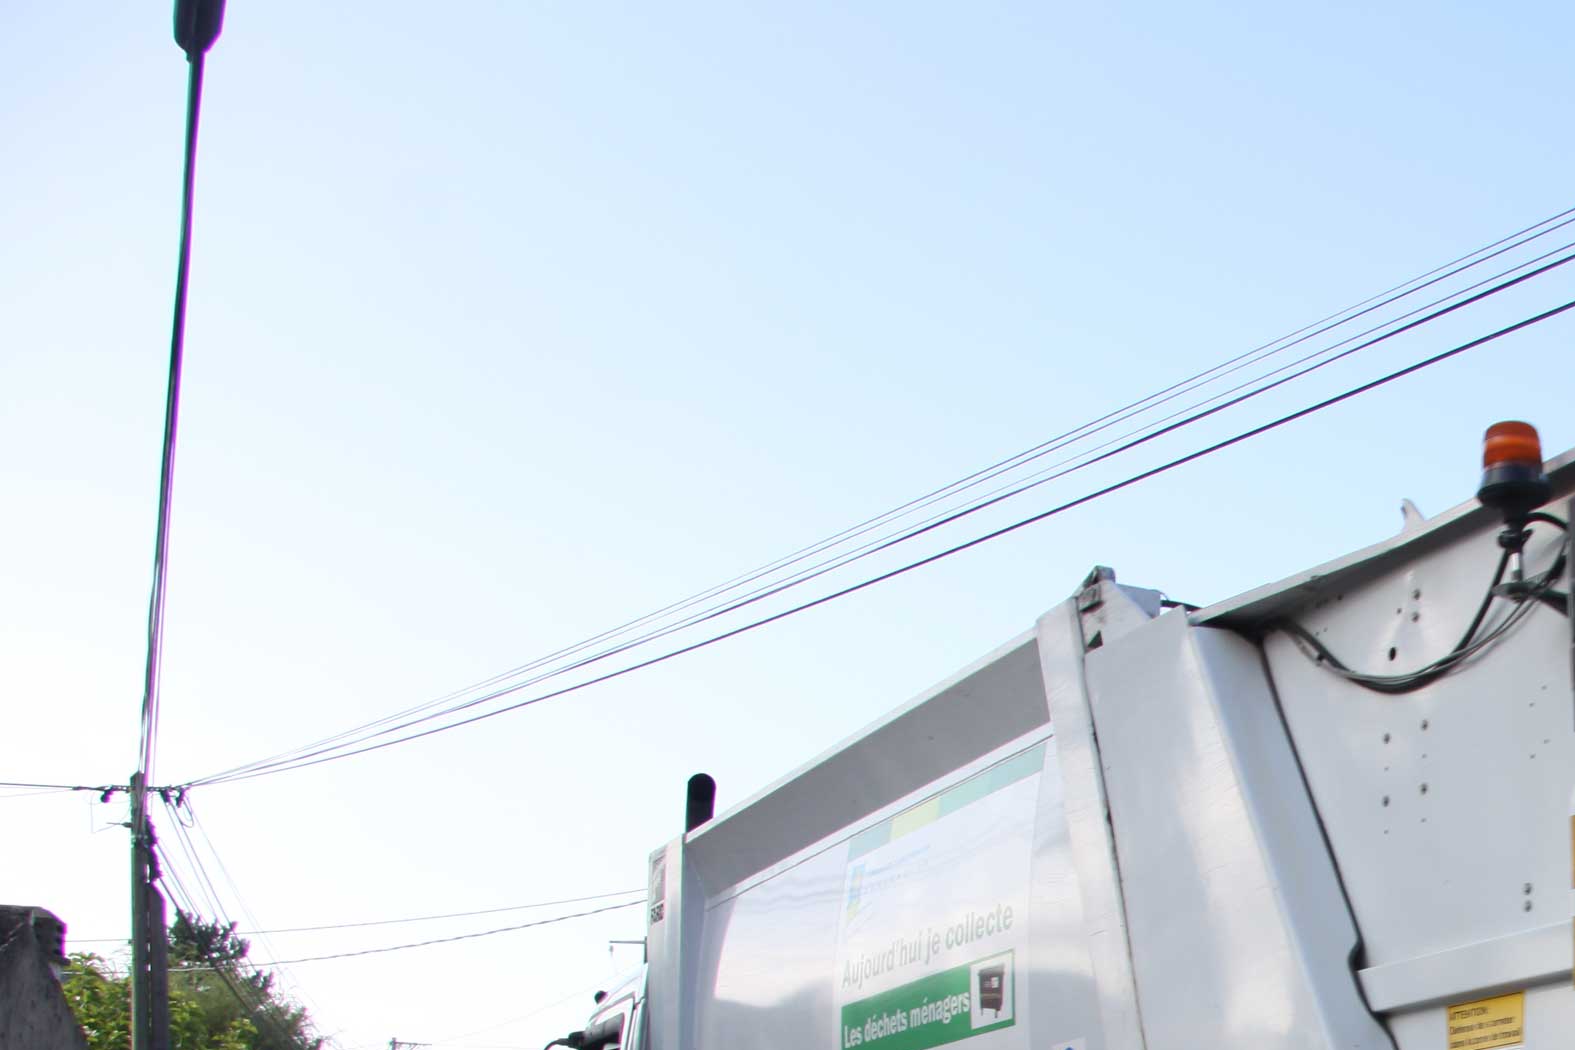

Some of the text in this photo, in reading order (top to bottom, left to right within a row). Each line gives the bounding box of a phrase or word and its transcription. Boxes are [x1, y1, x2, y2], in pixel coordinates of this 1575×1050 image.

[841, 903, 1014, 990] Aujourd'hui je collecte
[844, 991, 970, 1048] Les déchets ménagers
